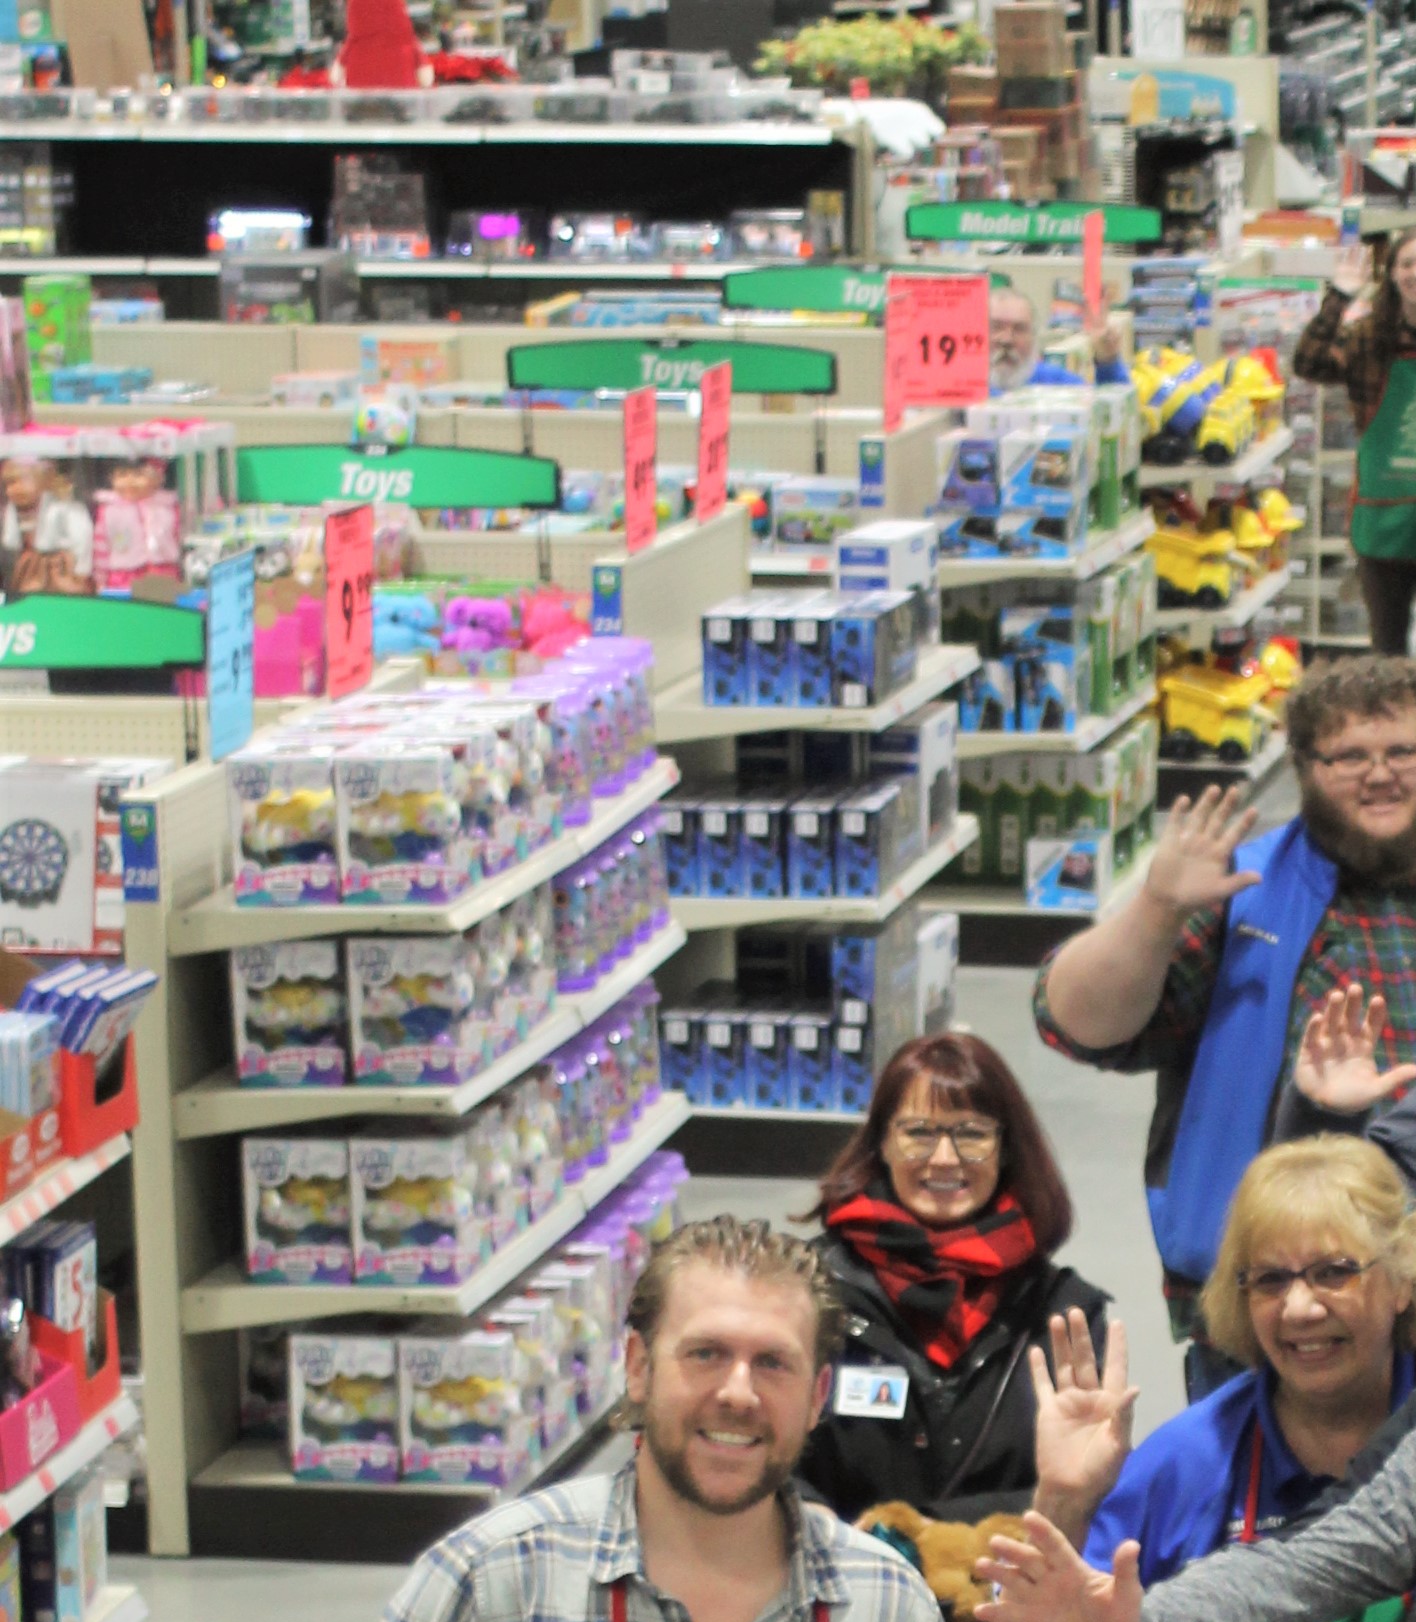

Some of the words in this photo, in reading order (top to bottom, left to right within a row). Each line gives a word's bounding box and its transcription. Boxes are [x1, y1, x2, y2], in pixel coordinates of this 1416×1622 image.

[959, 213, 1029, 237] Model
[842, 280, 887, 303] Toy
[918, 335, 957, 365] 19
[640, 353, 706, 385] Toys
[340, 461, 414, 500] Toys
[341, 579, 355, 641] 9
[0, 621, 37, 661] ys
